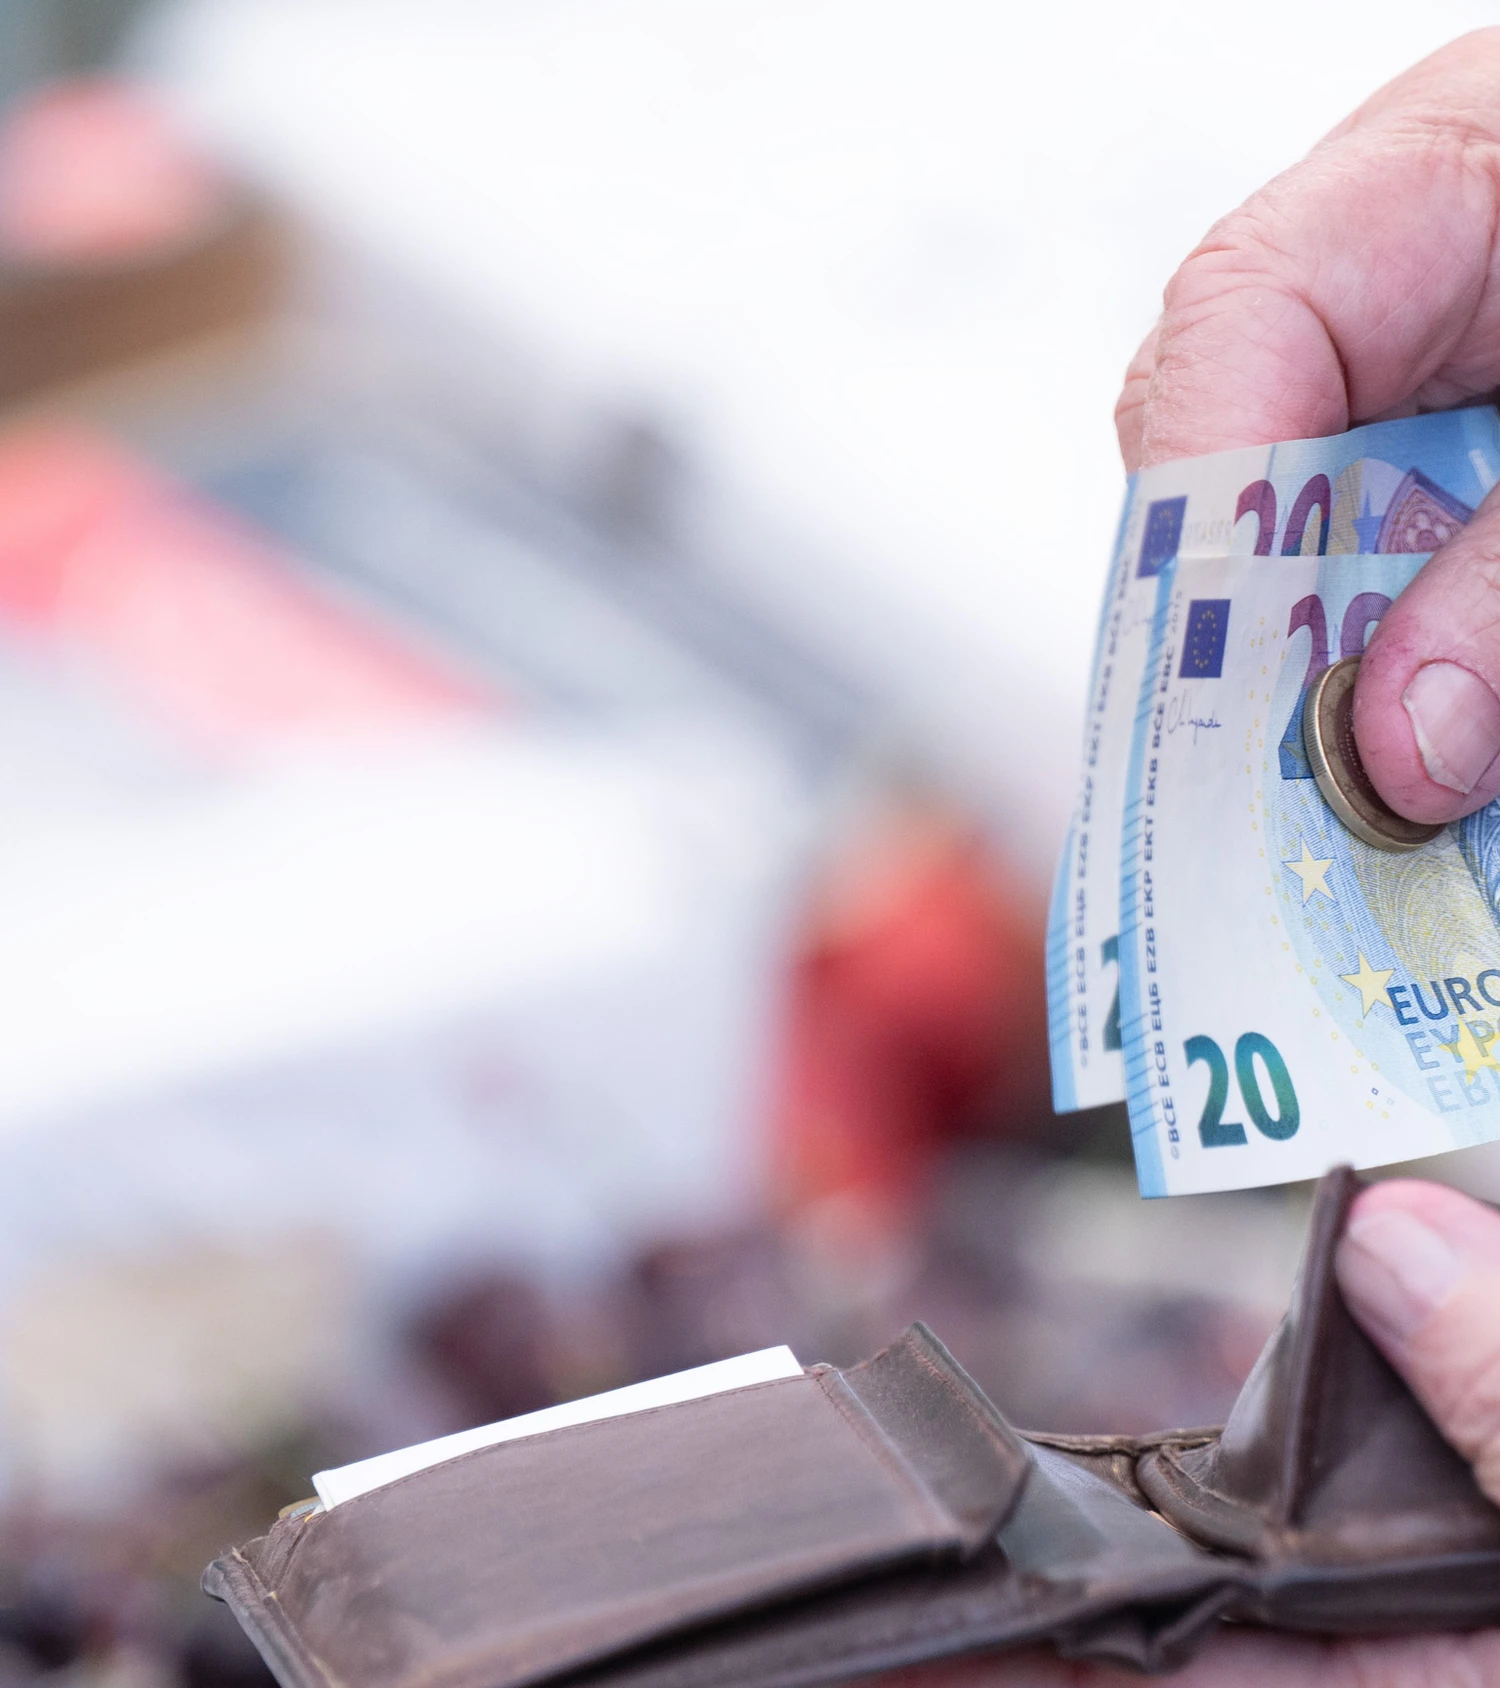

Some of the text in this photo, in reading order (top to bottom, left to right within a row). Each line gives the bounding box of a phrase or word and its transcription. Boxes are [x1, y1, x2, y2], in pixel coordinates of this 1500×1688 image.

[1147, 758, 1158, 806] EKB
[1143, 871, 1153, 918] EKP
[1145, 927, 1157, 974] EZB
[1154, 1041, 1170, 1087] ECB
[1183, 1031, 1301, 1149] 20
